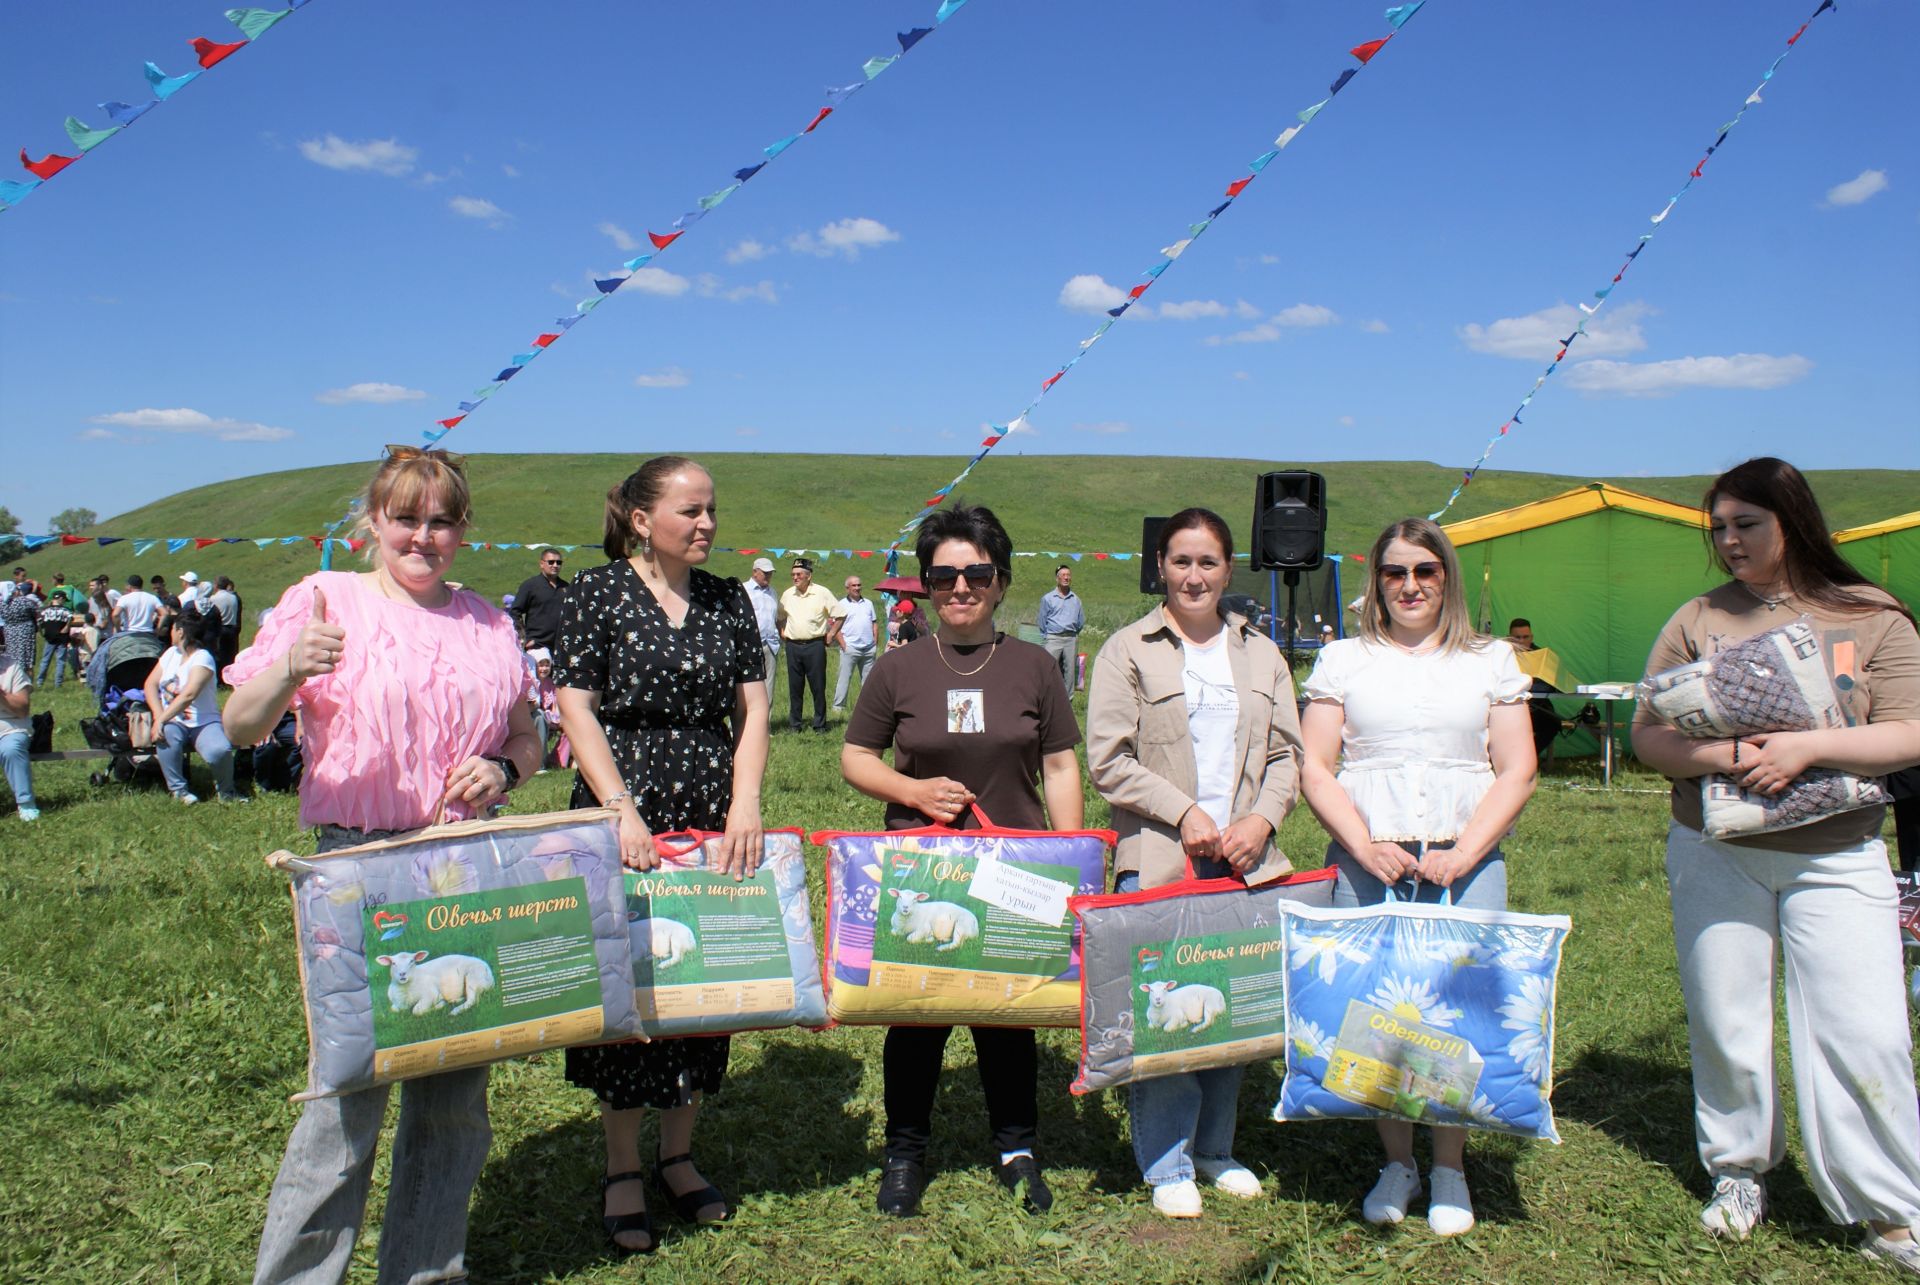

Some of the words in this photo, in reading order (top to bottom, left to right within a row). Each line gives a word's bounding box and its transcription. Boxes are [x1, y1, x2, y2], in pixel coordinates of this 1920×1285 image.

[636, 879, 702, 897] Овечья
[706, 883, 767, 902] шерсть
[1006, 895, 1036, 911] урын
[427, 905, 501, 931] Овечья
[508, 896, 578, 923] шерсть
[1176, 944, 1234, 965] Овечья
[1239, 939, 1282, 961] шерс
[1370, 1014, 1463, 1058] Одеяло!!!
